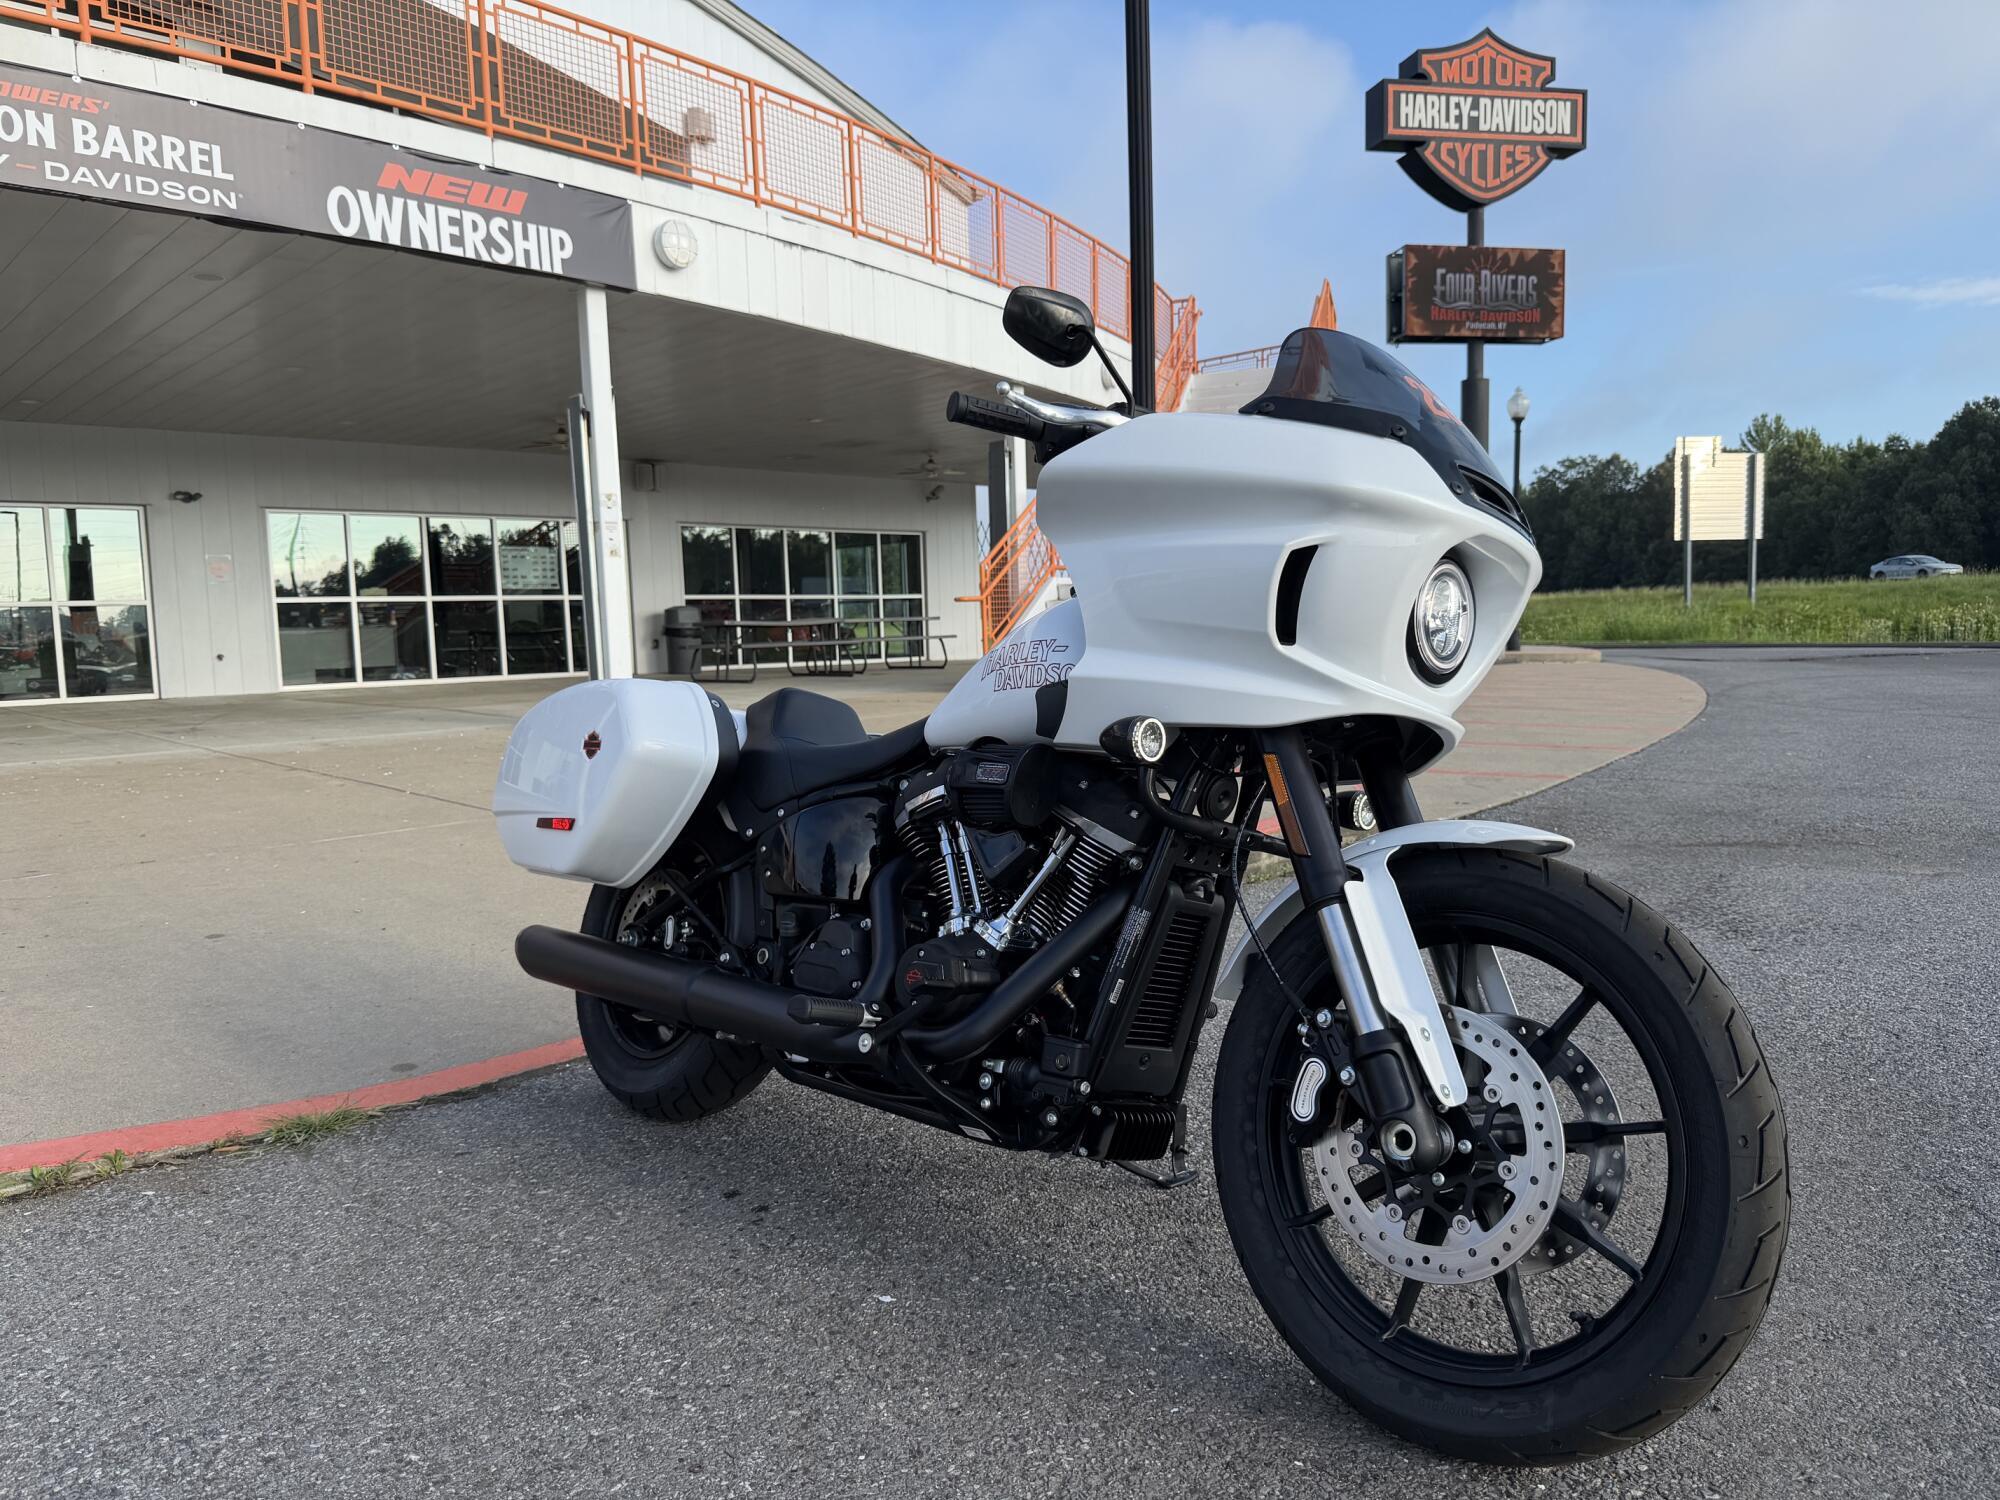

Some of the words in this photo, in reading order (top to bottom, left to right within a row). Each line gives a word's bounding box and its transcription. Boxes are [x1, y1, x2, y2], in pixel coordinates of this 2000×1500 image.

[1441, 47, 1532, 88] MOTOR
[1400, 92, 1571, 135] HARLEY-DAVIDSON
[71, 117, 235, 181] BARREL
[1440, 143, 1532, 189] CYCLES
[43, 160, 237, 210] DAVIDSON
[376, 162, 529, 216] NEW
[326, 185, 573, 275] OWNERSHIP
[981, 638, 1069, 682] HARLEY-
